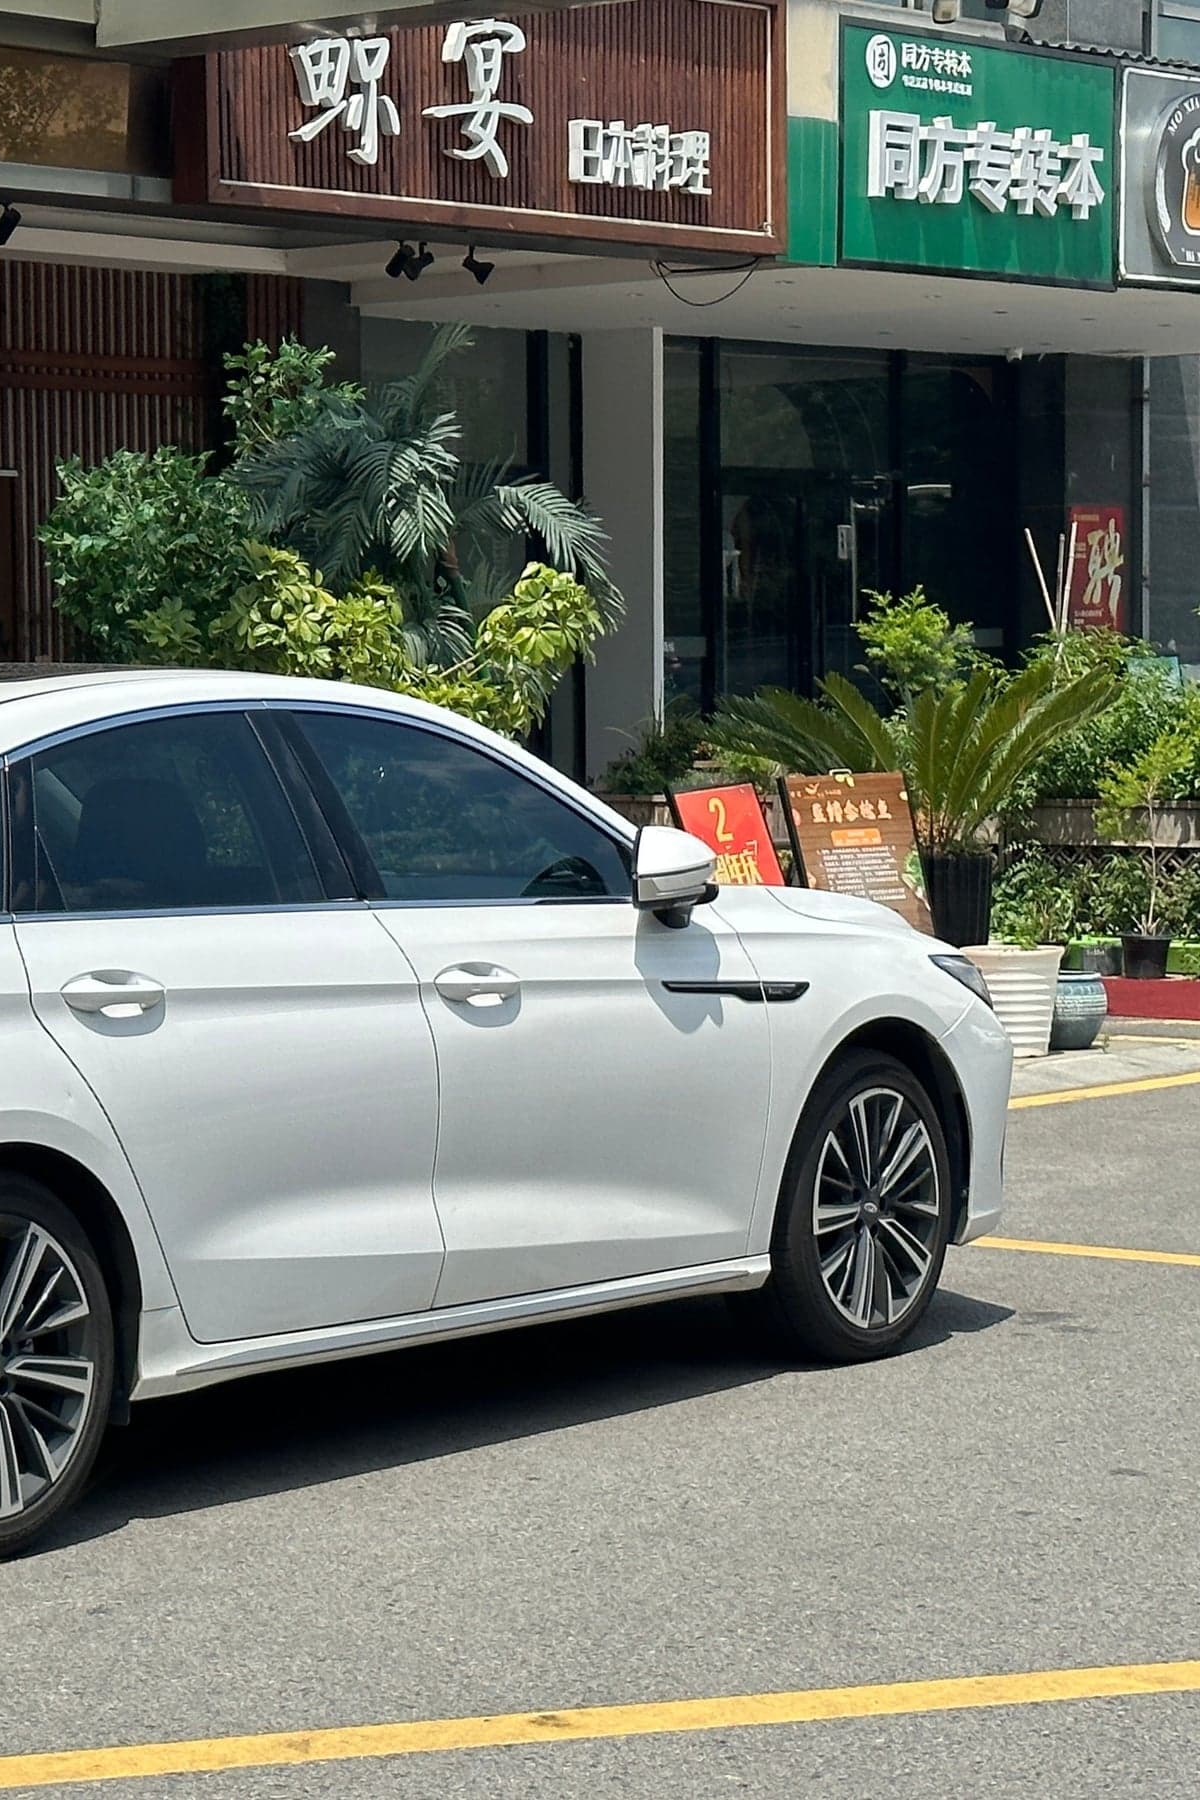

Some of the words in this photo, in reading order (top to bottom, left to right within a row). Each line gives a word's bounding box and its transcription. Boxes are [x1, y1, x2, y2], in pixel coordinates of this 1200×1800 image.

[901, 42, 972, 78] 同方专转本
[568, 119, 713, 196] 日本料理
[867, 110, 1104, 219] 同方专转本
[708, 797, 734, 842] 2
